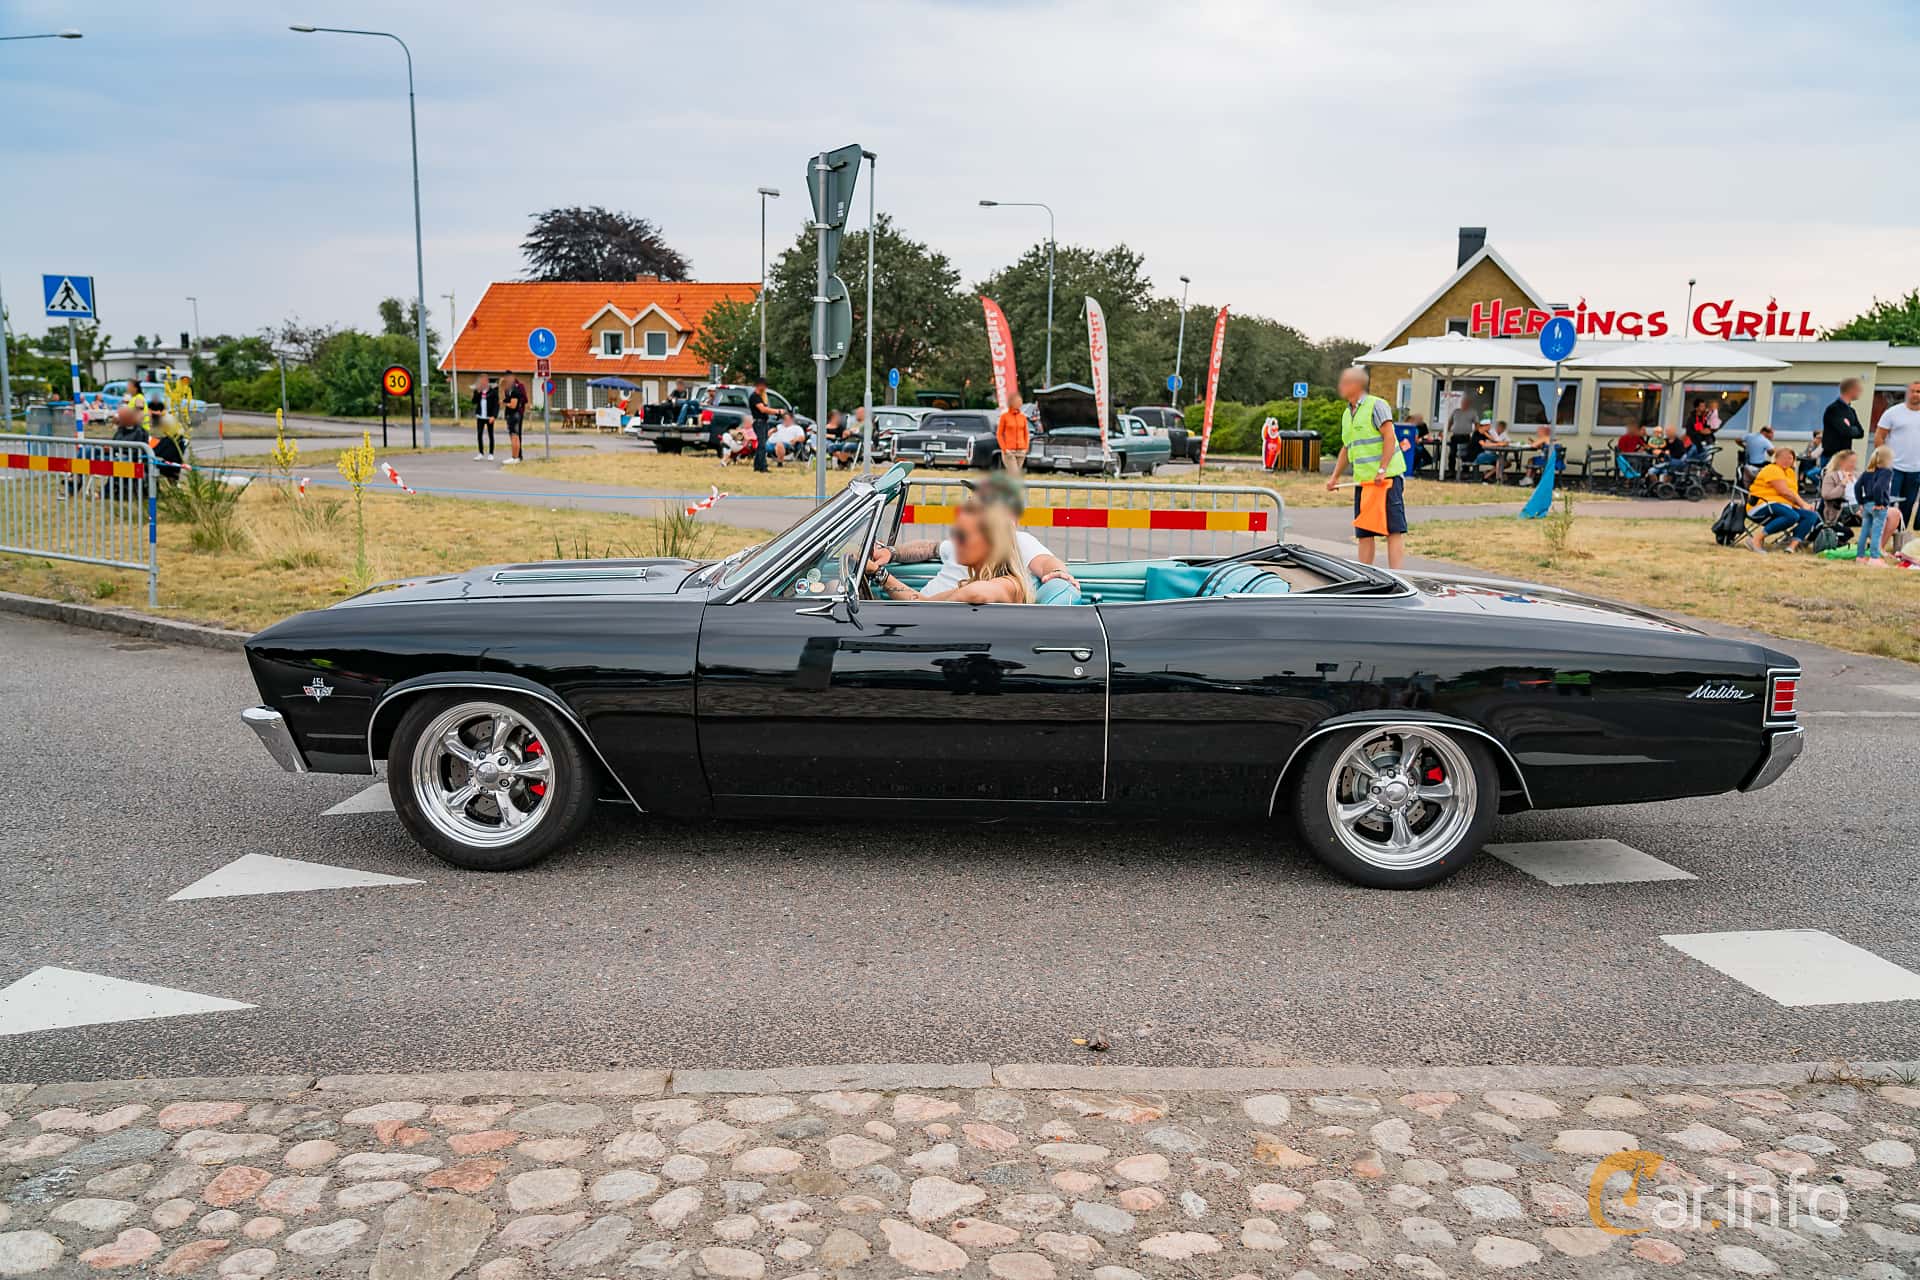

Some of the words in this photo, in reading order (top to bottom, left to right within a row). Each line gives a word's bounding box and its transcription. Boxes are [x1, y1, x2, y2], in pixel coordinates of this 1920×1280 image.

[1692, 296, 1816, 341] GRILL
[389, 375, 406, 388] 30
[1686, 685, 1754, 699] Malibu
